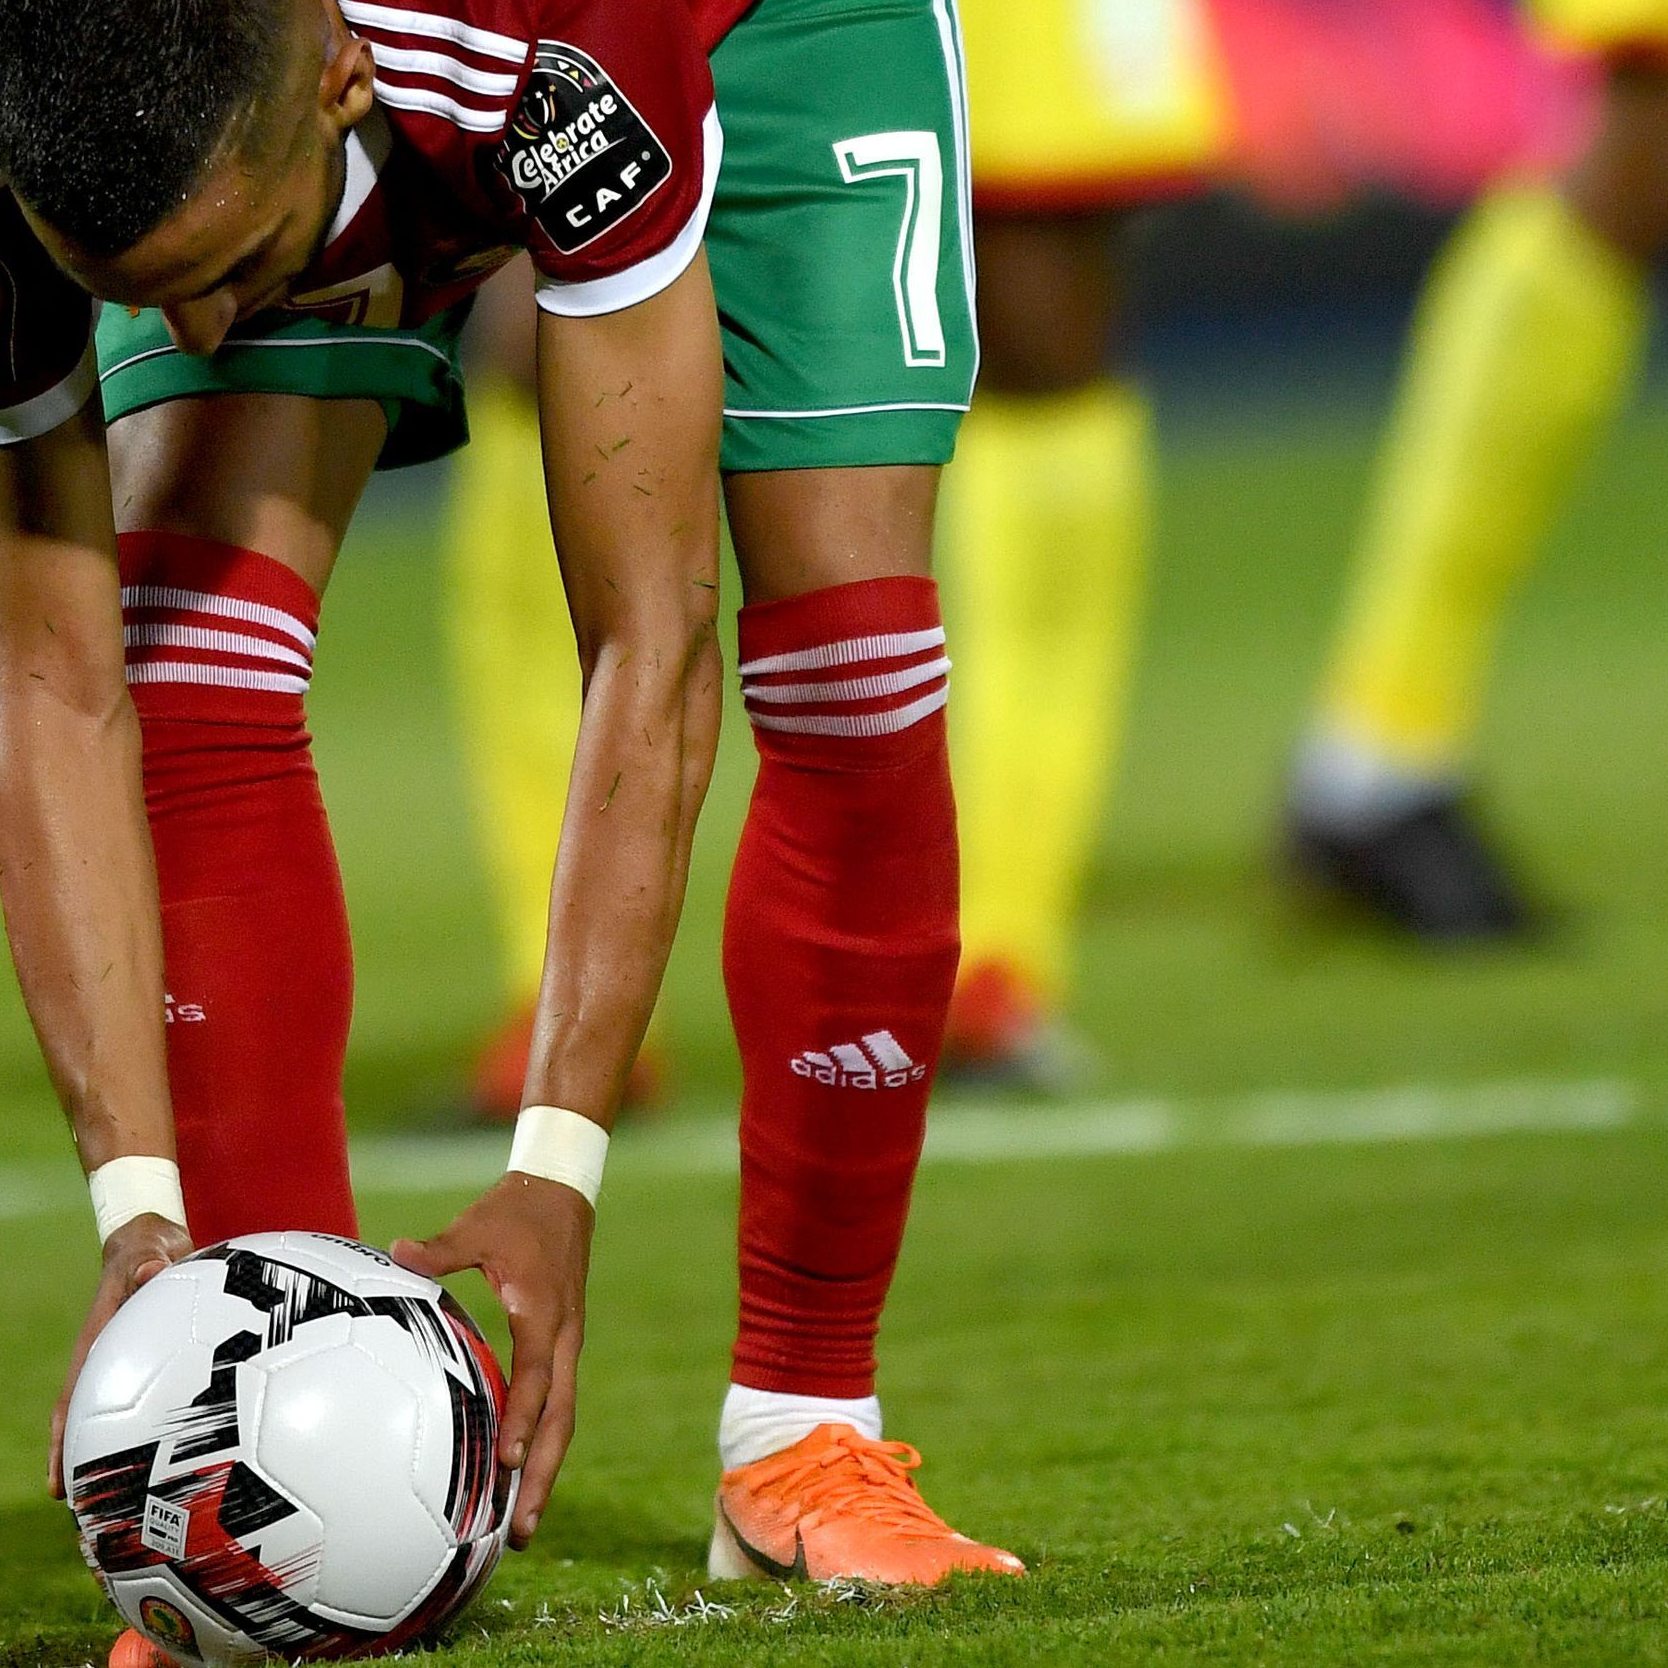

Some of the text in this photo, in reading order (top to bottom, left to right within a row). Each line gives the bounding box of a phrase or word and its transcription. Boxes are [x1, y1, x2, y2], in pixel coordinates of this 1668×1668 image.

[512, 93, 618, 189] Celebrate
[539, 129, 611, 196] Africa
[565, 160, 642, 228] CAF
[831, 130, 946, 368] 7
[790, 1058, 927, 1090] adidas
[151, 1504, 180, 1527] FIFA
